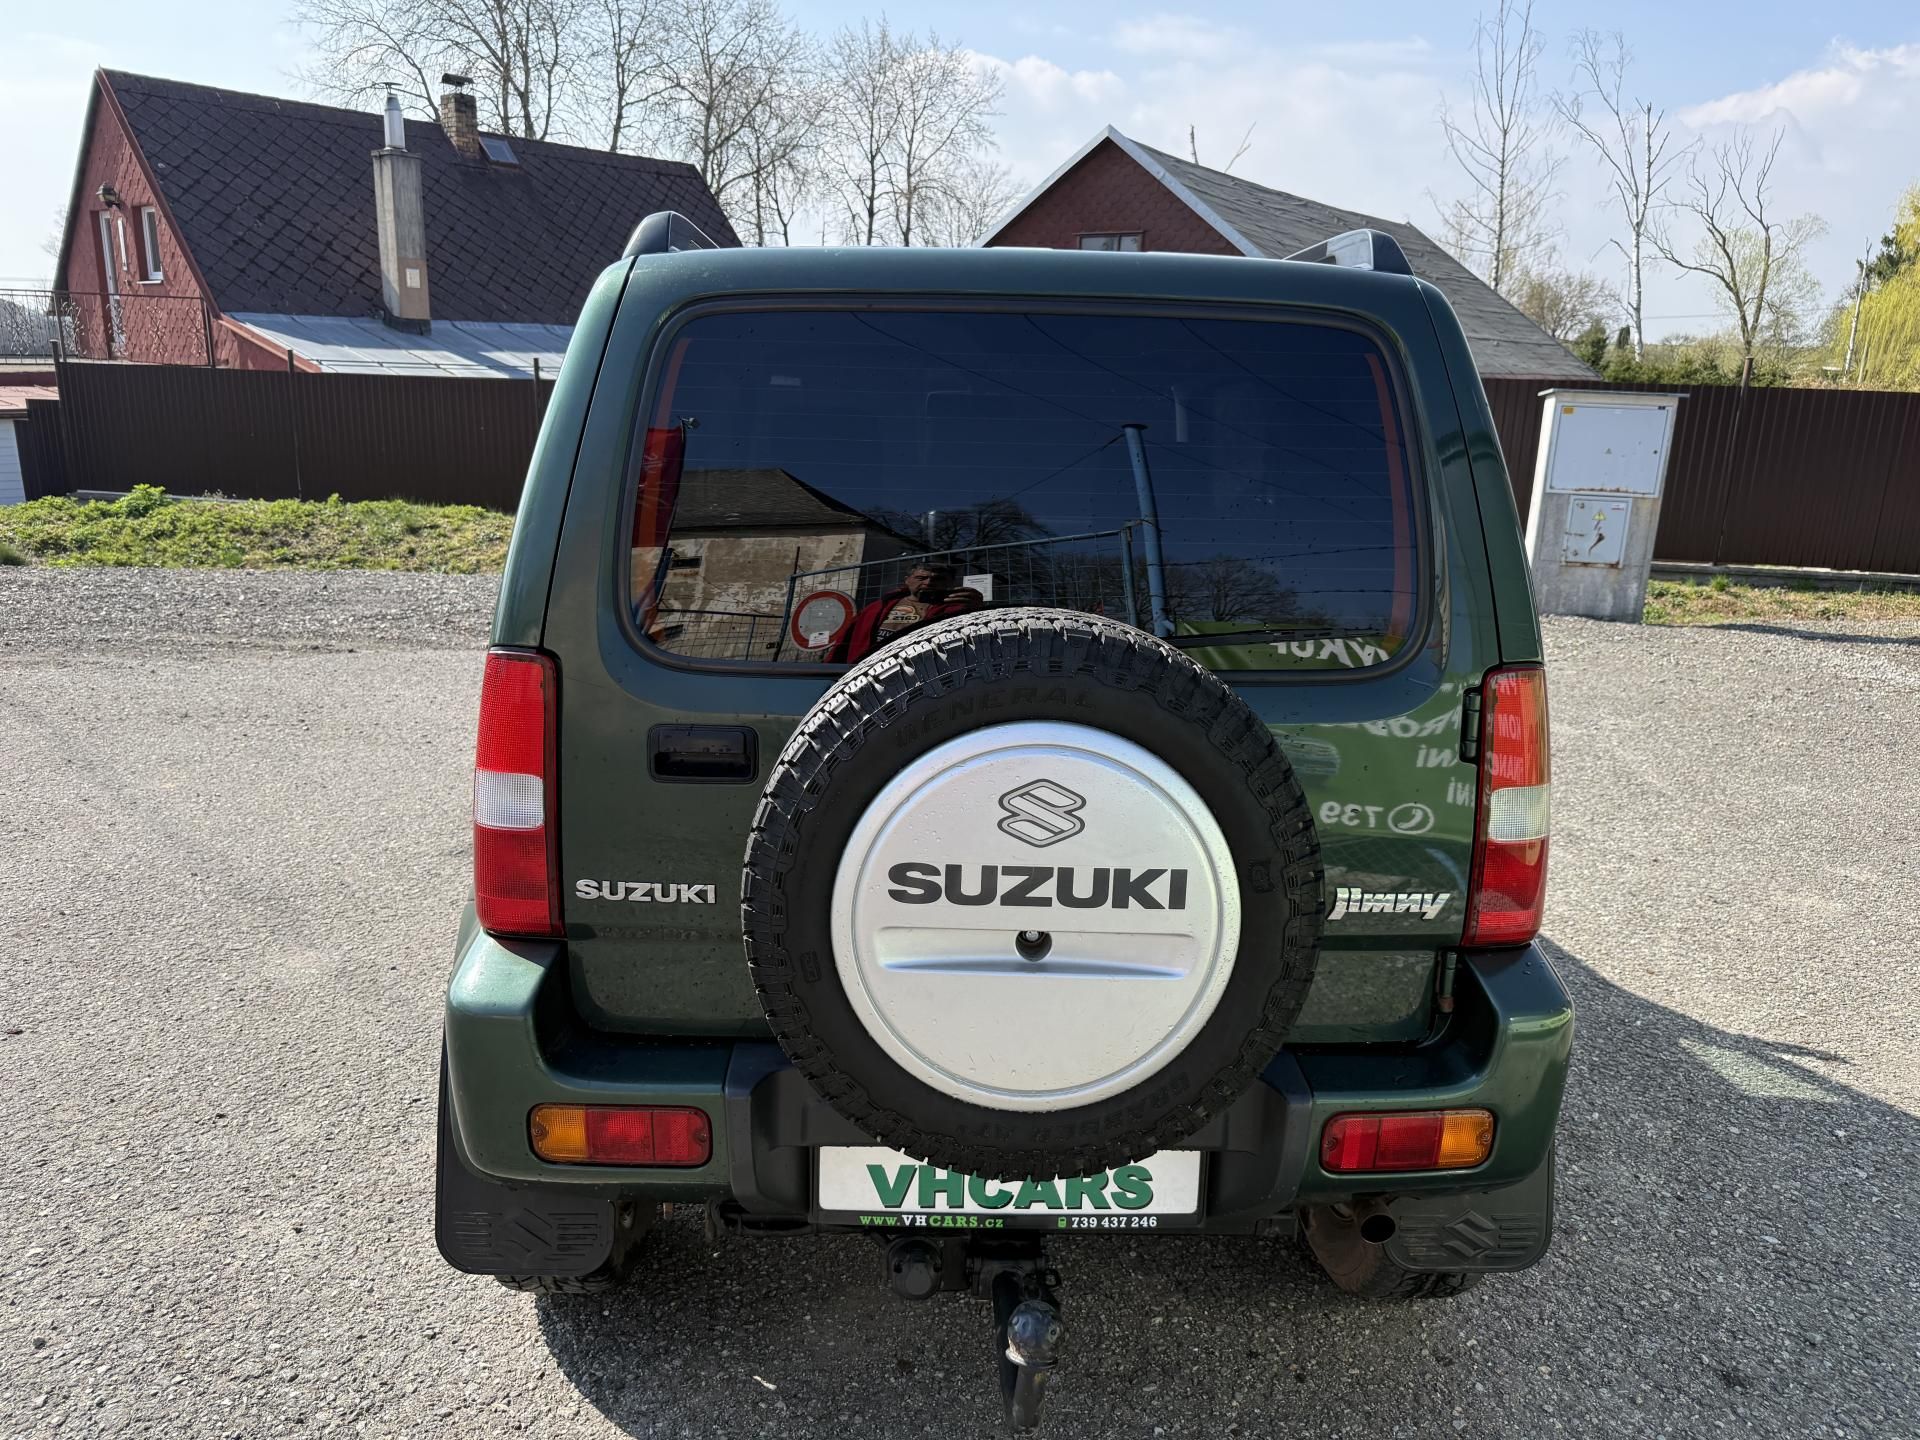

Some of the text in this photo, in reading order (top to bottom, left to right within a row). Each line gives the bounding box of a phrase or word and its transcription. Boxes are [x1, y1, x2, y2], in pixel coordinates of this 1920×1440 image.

[575, 878, 717, 904] SUZUKI
[886, 862, 1189, 910] SUZUKI
[1327, 886, 1451, 921] Jimny
[866, 1163, 1155, 1211] VHCARS
[859, 1214, 1004, 1229] www.VHCARS.cz
[1071, 1216, 1158, 1229] 739 437 246
